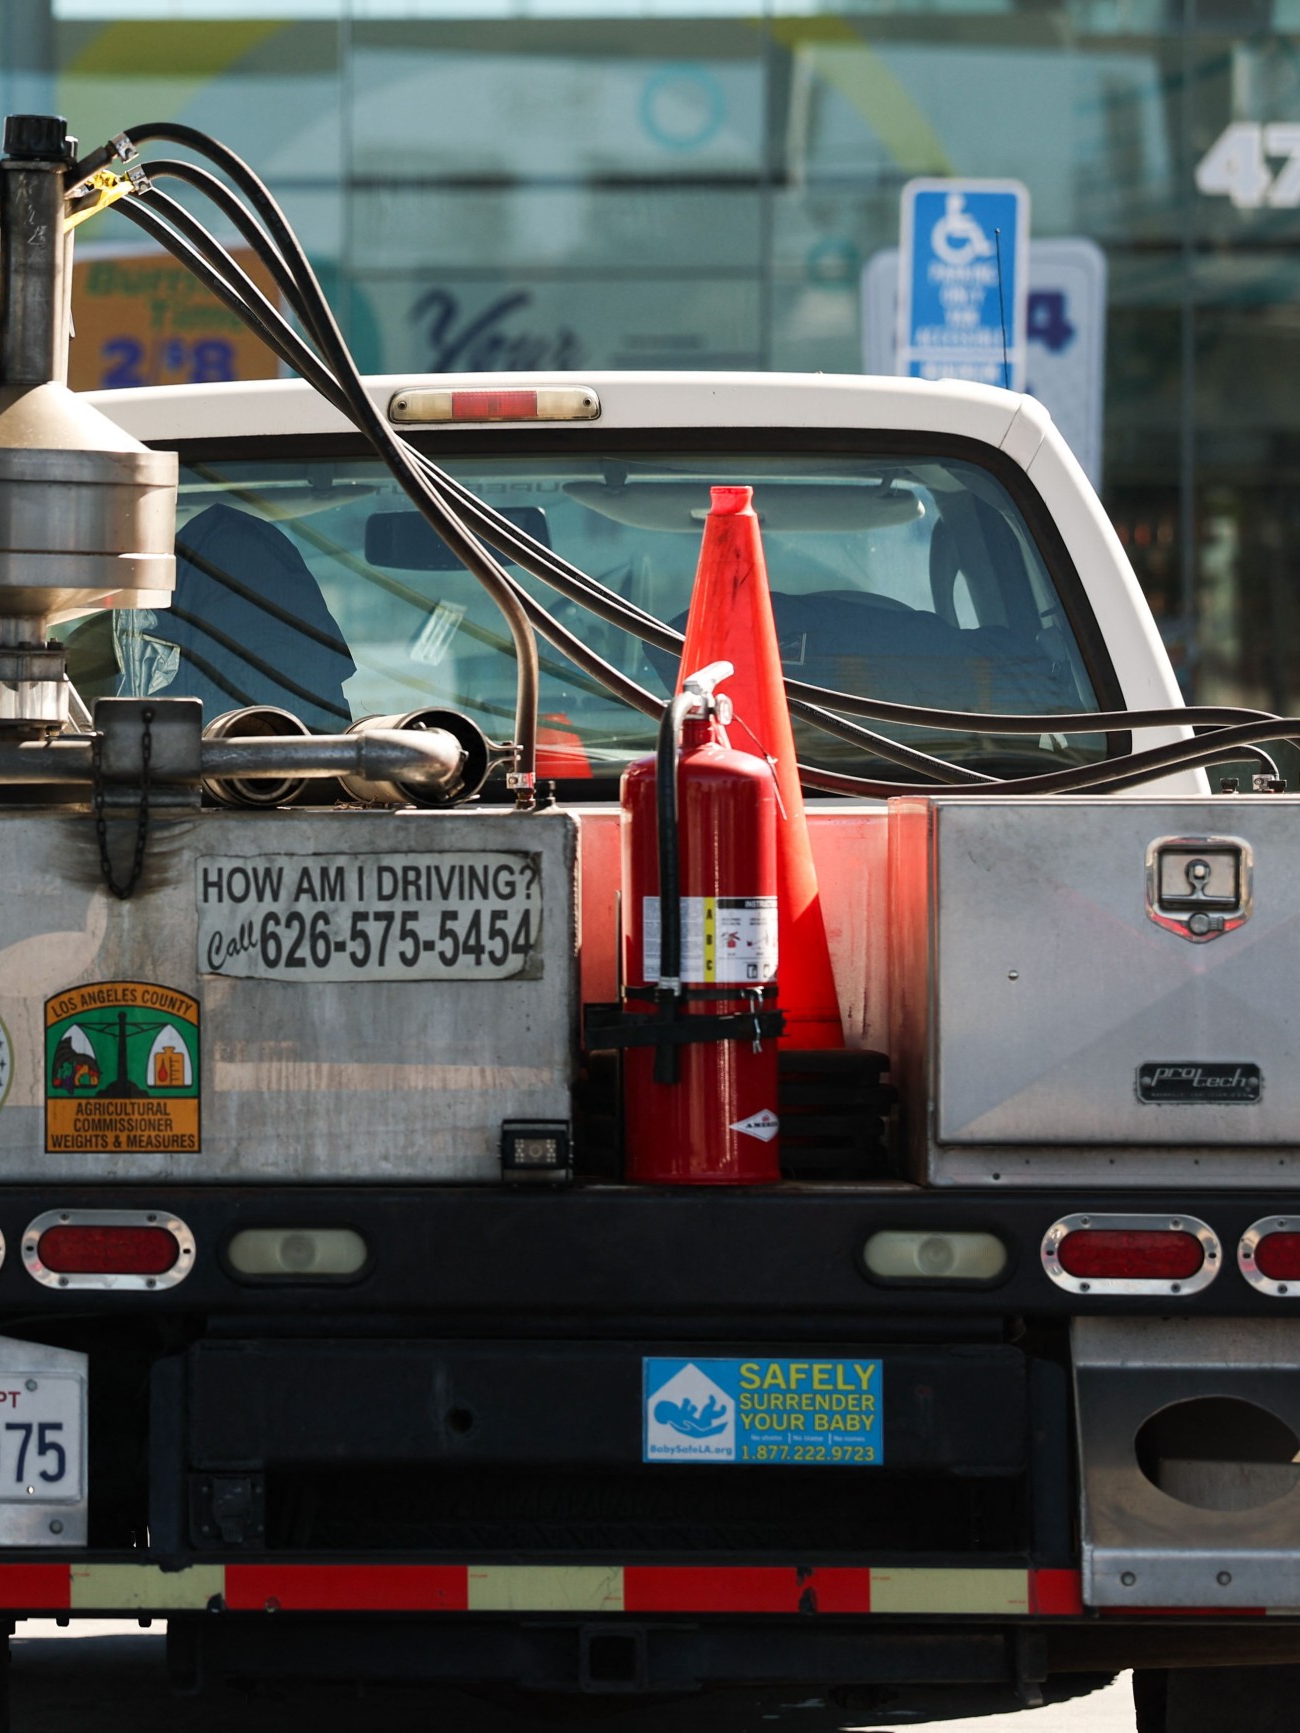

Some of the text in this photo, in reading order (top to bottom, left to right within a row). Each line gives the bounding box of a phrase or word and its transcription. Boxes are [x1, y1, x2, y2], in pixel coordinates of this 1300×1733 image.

[203, 864, 537, 903] HOW AM I DRIVING?
[207, 909, 535, 971] Call 626-575-5454
[51, 988, 193, 1018] LOS ANGELES COUNTY
[76, 1101, 171, 1117] AGRICULTURAL
[73, 1118, 173, 1133] COMMISSIONER
[51, 1134, 195, 1149] WEIGHTS & MEASURES
[739, 1362, 876, 1391] SAFELY
[739, 1393, 875, 1411] SURRENDER
[740, 1413, 875, 1431] YOUR BABY
[740, 1445, 876, 1461] 1.877.222.9723
